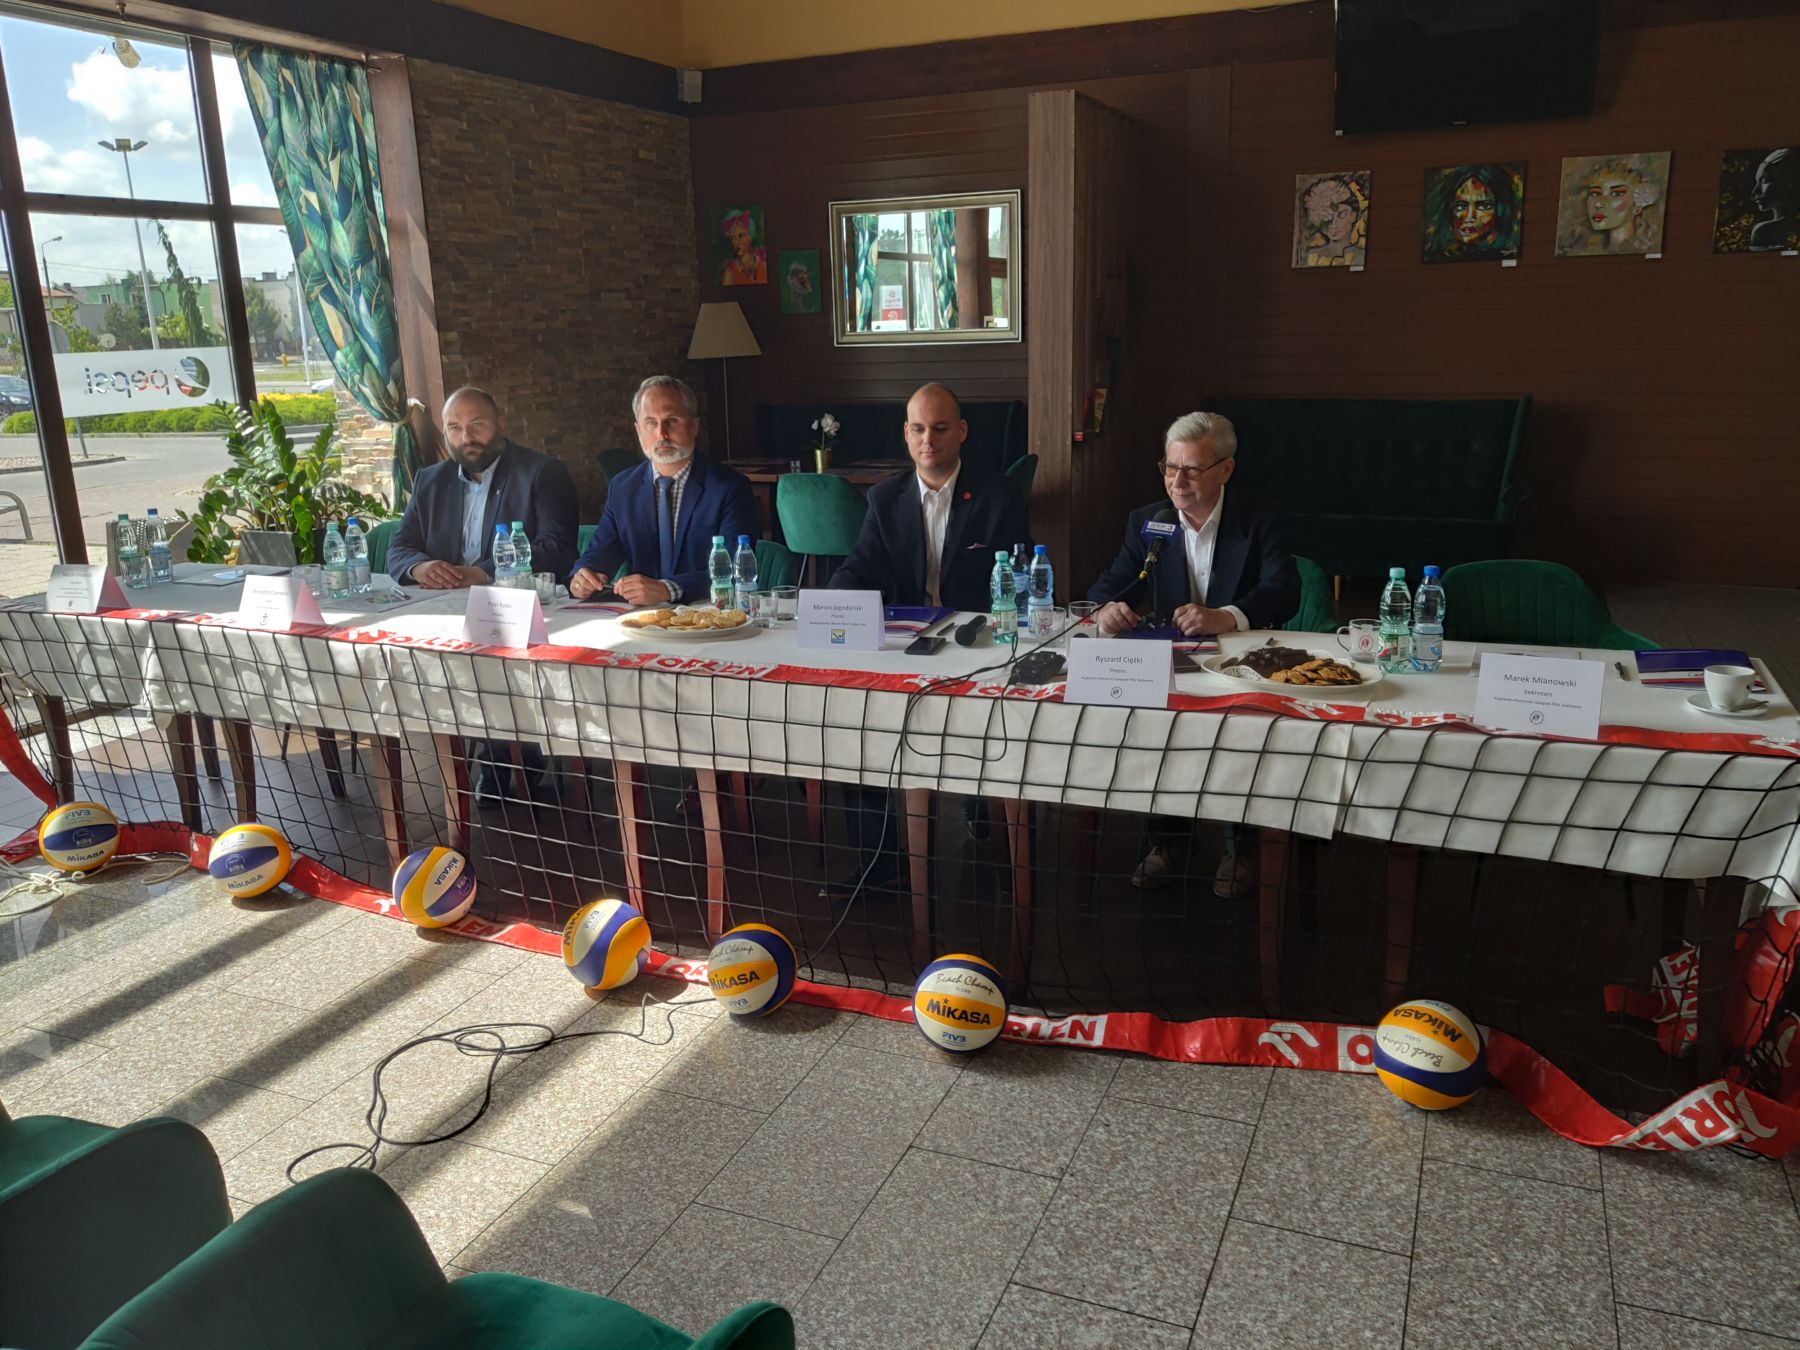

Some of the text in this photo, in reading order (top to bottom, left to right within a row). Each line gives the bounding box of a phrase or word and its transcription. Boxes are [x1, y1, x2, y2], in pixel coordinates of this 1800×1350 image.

[656, 657, 768, 676] ORLEN
[1095, 655, 1122, 664] Ryszard
[1503, 673, 1577, 688] Marek Mianowski
[1523, 689, 1553, 698] Sekretarz
[936, 973, 994, 995] Beach Champ
